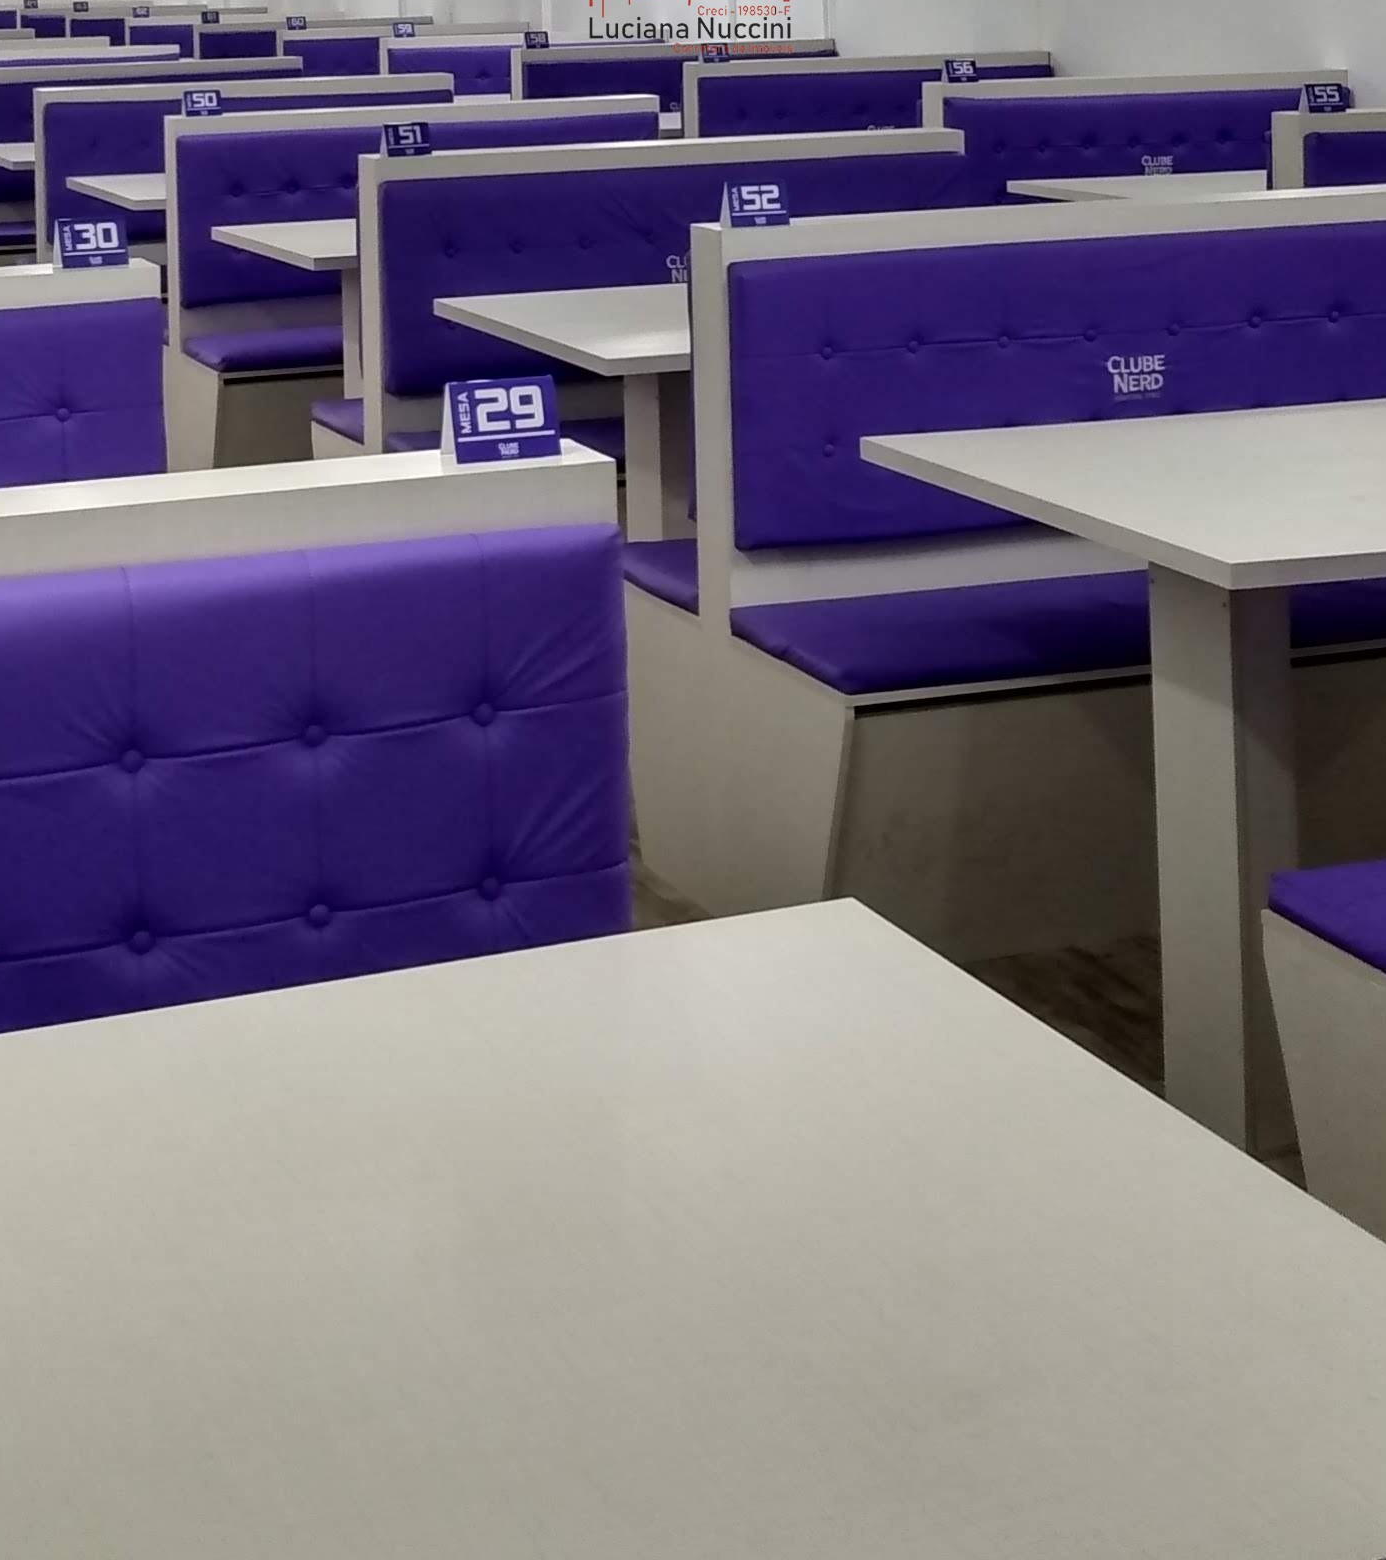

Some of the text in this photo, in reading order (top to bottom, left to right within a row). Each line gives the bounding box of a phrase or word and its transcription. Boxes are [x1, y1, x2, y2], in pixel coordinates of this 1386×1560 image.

[953, 62, 974, 75] 56
[192, 92, 218, 107] 50
[1316, 86, 1340, 102] 55
[398, 125, 422, 144] 51
[740, 184, 782, 211] 52
[73, 222, 120, 250] 30
[1107, 354, 1166, 374] CLUBE
[1113, 373, 1164, 393] NERD
[457, 391, 473, 434] MESA
[474, 385, 545, 432] 29
